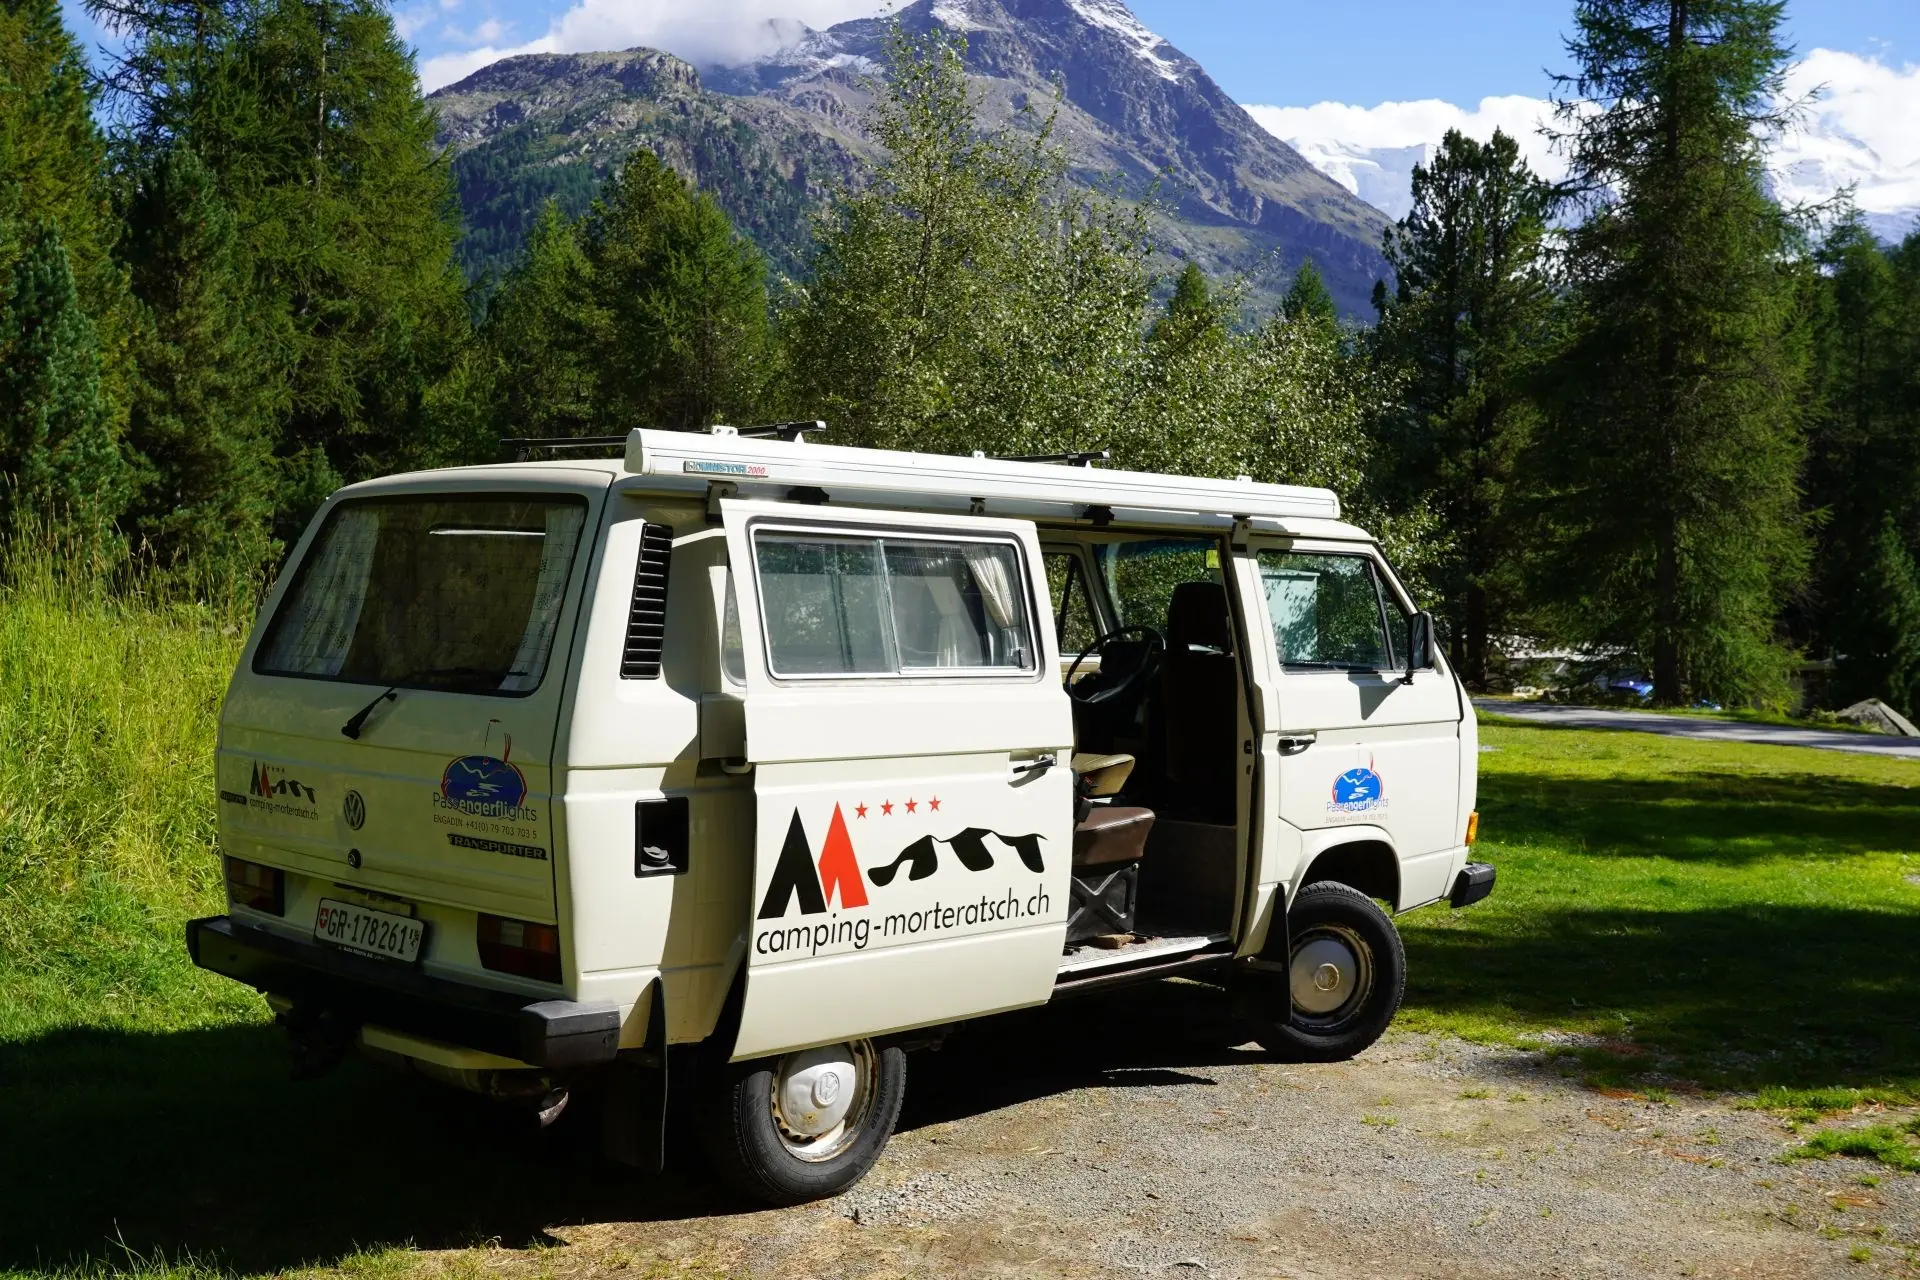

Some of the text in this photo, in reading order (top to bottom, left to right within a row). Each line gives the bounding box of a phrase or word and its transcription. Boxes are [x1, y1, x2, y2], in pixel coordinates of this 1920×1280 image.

[748, 466, 766, 475] 2000
[433, 792, 537, 822] Passengerflights
[448, 834, 544, 859] TRANSPORTER
[756, 883, 1050, 956] camping-morteratsch.ch
